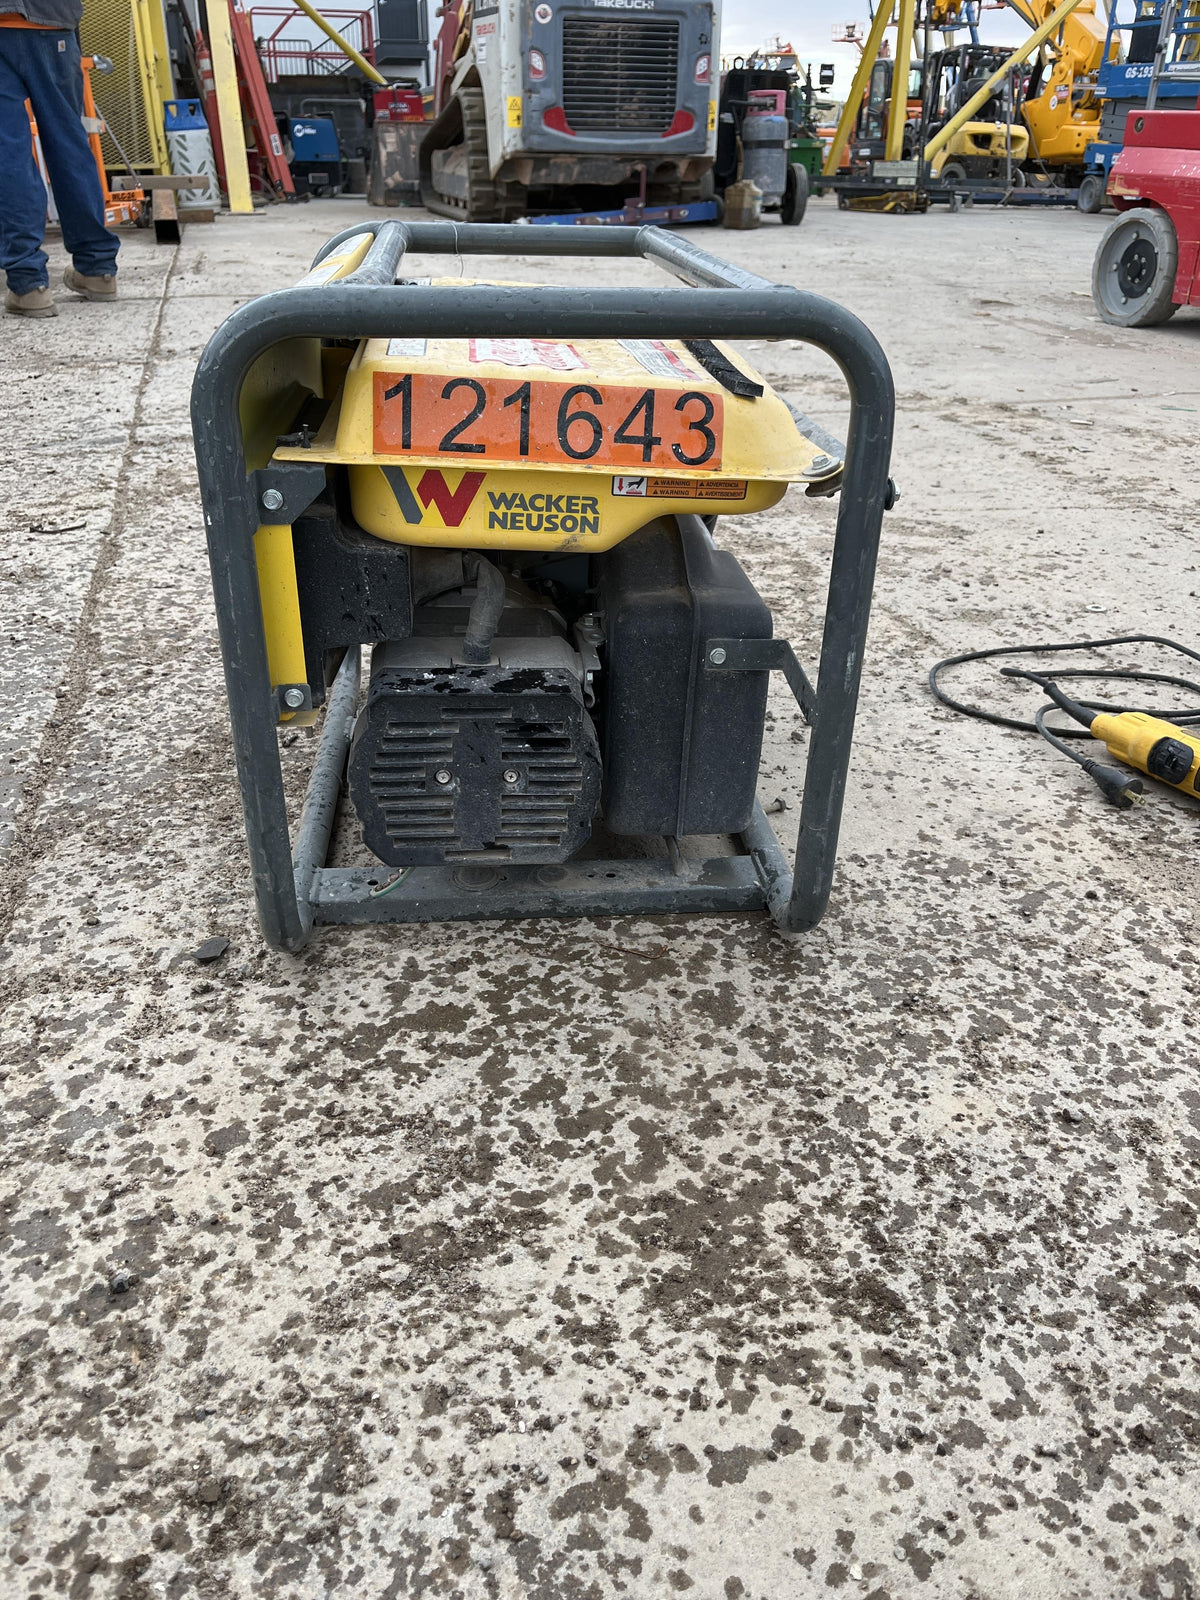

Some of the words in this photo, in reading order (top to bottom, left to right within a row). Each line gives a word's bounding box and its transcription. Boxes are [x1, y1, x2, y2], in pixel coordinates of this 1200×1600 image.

[1125, 66, 1154, 79] GS-193
[384, 374, 715, 466] 121643
[660, 479, 691, 487] WARNING
[487, 491, 600, 515] WACKER
[488, 511, 600, 534] NEUSON
